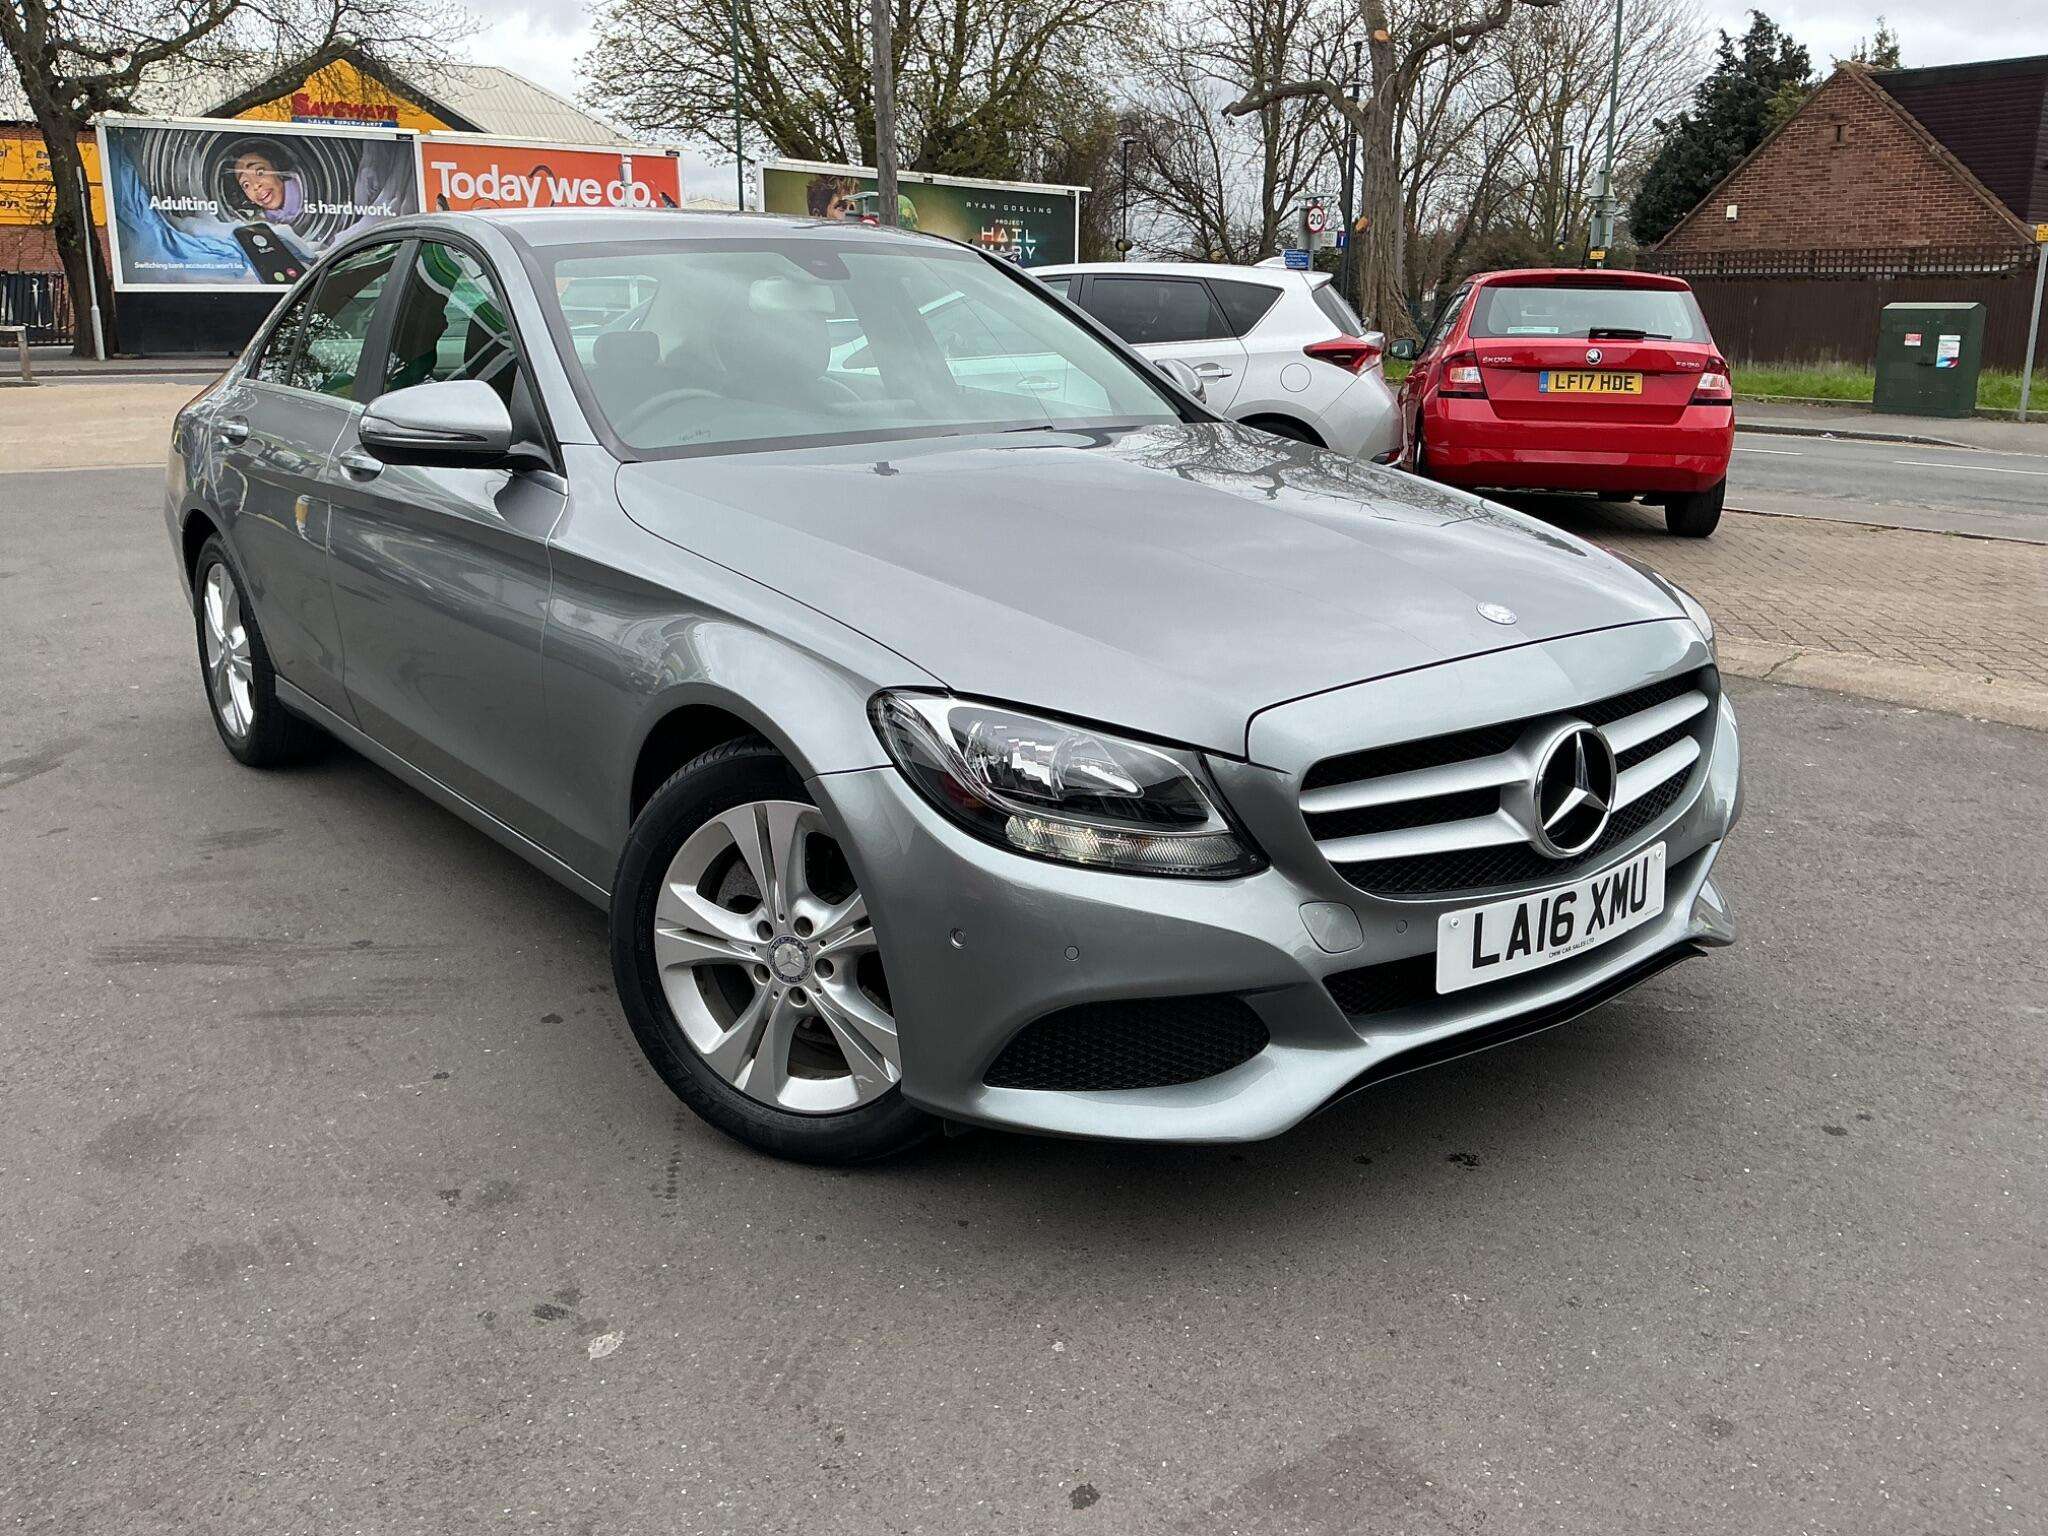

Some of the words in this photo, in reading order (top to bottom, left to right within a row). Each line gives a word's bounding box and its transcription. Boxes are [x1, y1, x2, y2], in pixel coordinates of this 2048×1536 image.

[431, 161, 542, 208] Today
[546, 177, 602, 205] we
[606, 179, 657, 207] do.
[149, 195, 219, 215] Adulting
[303, 199, 317, 214] is
[318, 199, 353, 215] hard
[354, 202, 397, 217] work.
[966, 201, 996, 210] RYAN
[1003, 204, 1053, 214] GOSLING
[995, 218, 1025, 226] PROJECT
[1310, 213, 1323, 225] 20
[981, 226, 1036, 243] HAIL
[134, 261, 168, 270] Switching
[1555, 374, 1596, 390] LF17
[1600, 374, 1636, 392] HDE
[1472, 890, 1578, 970] LA16
[1586, 856, 1650, 937] XMU
